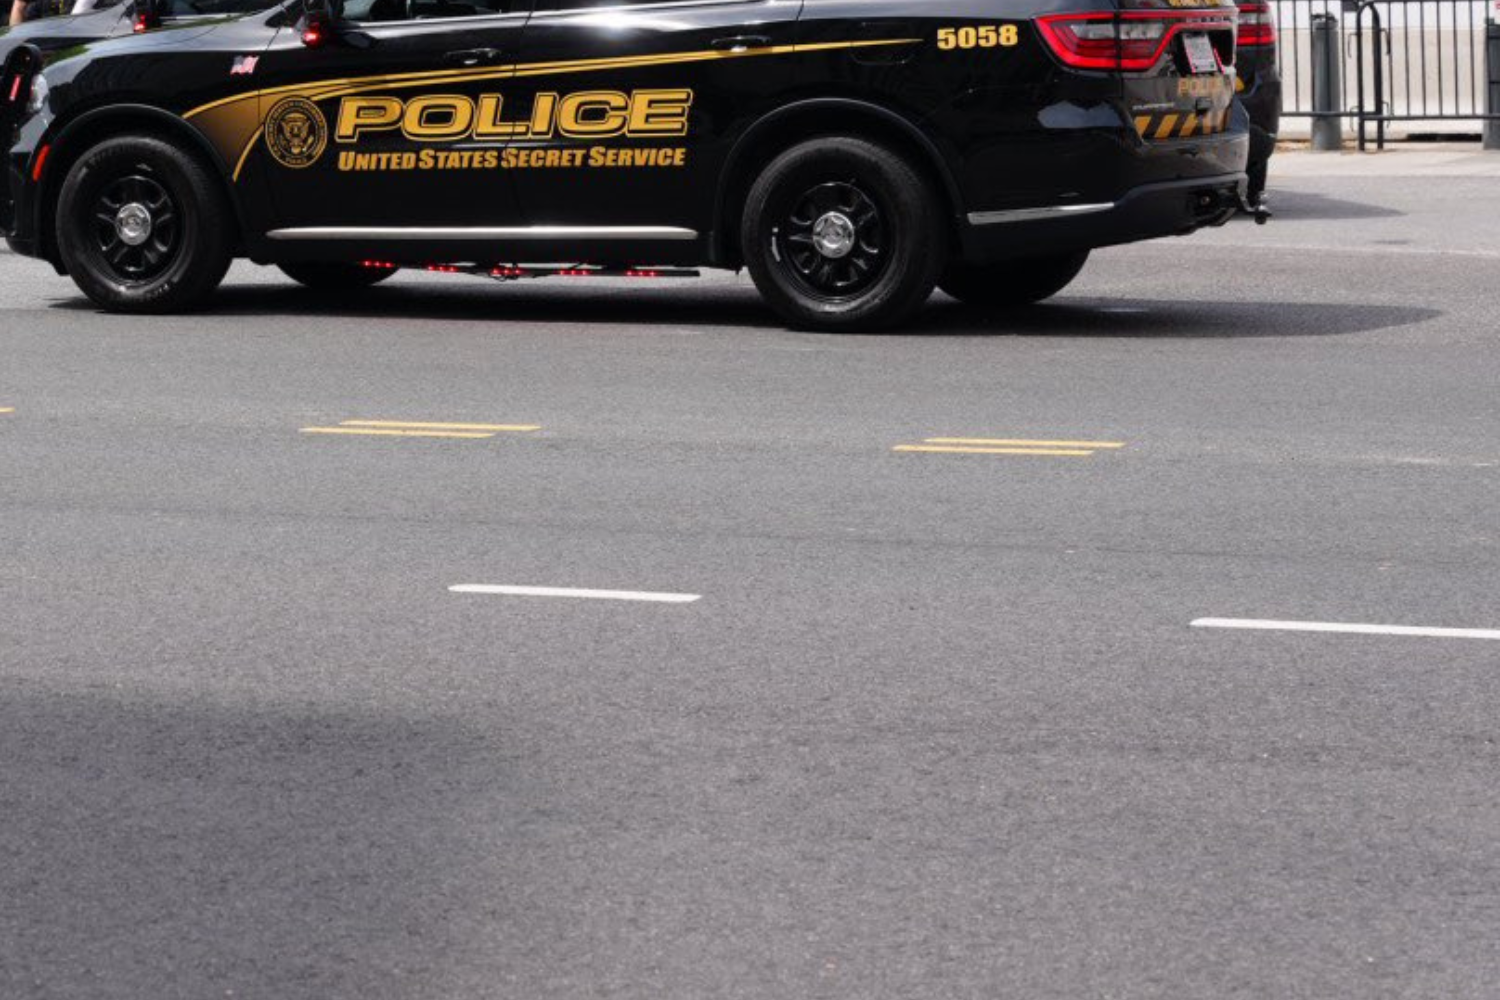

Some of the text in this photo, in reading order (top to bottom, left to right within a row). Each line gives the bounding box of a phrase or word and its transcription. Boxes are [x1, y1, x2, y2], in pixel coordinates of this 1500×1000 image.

[937, 23, 1018, 50] 5058
[335, 88, 693, 143] POLICE
[338, 146, 686, 171] UNITED STATES SECRET SERVICE
